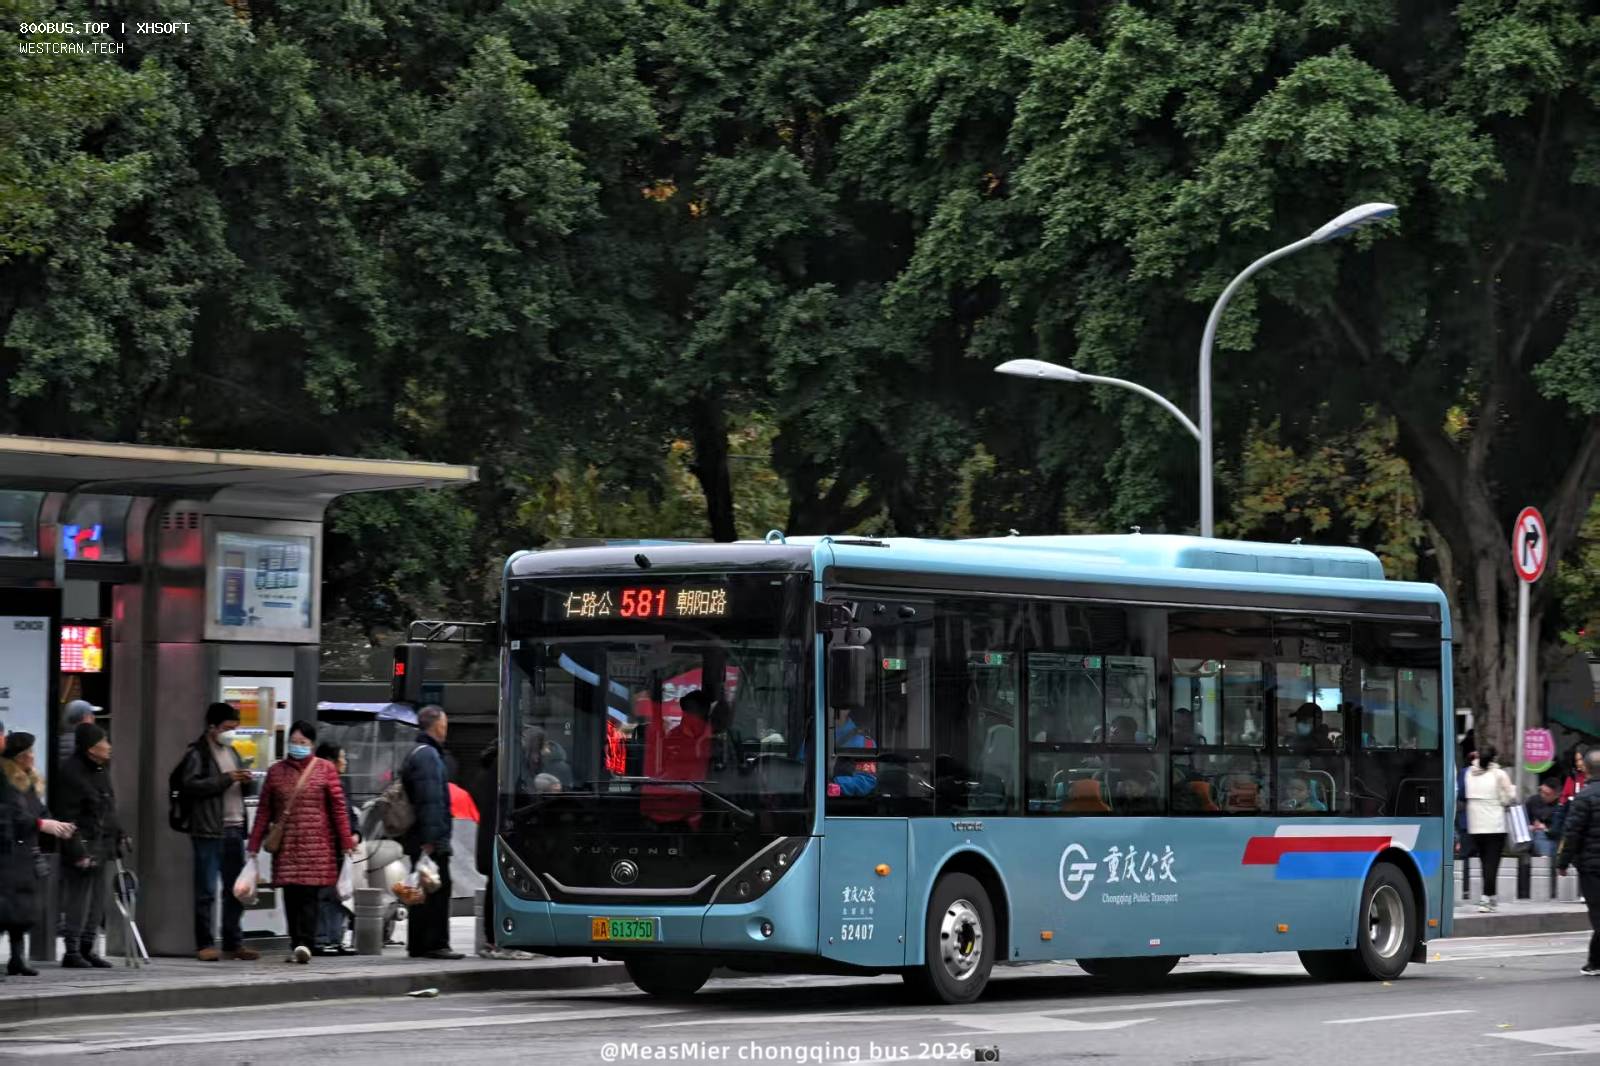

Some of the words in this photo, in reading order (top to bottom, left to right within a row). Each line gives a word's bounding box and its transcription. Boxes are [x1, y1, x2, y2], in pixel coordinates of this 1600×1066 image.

[620, 589, 666, 617] 581
[676, 588, 728, 616] 朝阳路
[573, 846, 679, 855] YUTONG
[1102, 845, 1177, 884] 重庆公交
[841, 924, 874, 941] 52407
